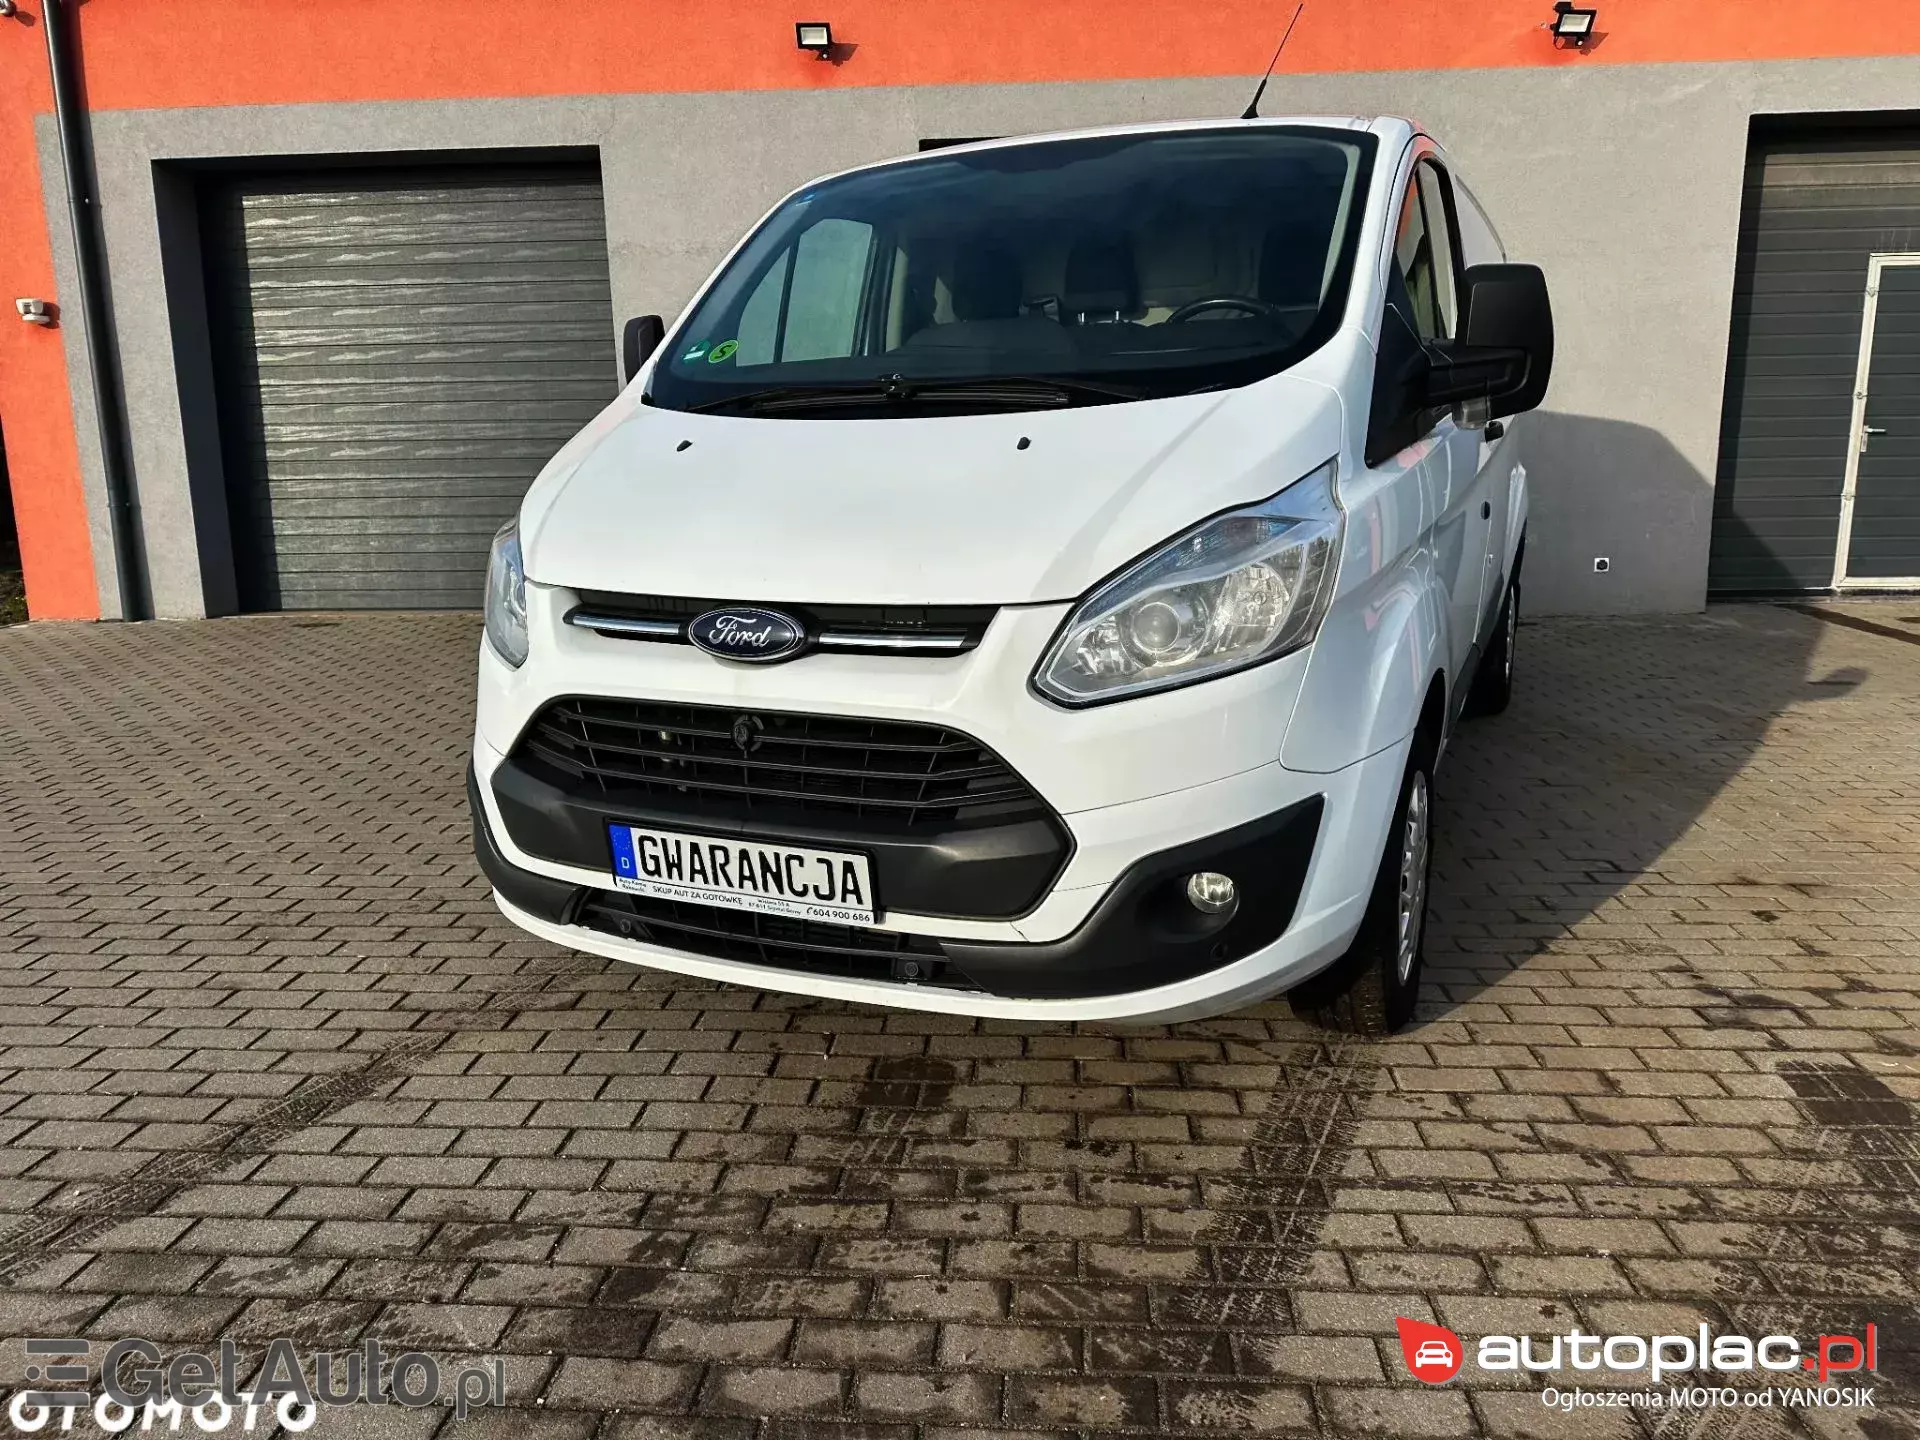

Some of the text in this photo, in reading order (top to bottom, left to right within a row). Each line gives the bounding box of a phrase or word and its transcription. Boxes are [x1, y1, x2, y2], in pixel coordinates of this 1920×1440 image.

[709, 615, 771, 648] Ford
[621, 857, 630, 869] D
[637, 834, 865, 905] GWARANCJA
[652, 885, 672, 894] SKUP
[673, 889, 690, 897] AUT
[690, 891, 702, 899] ZA
[813, 908, 870, 922] 604 900 686
